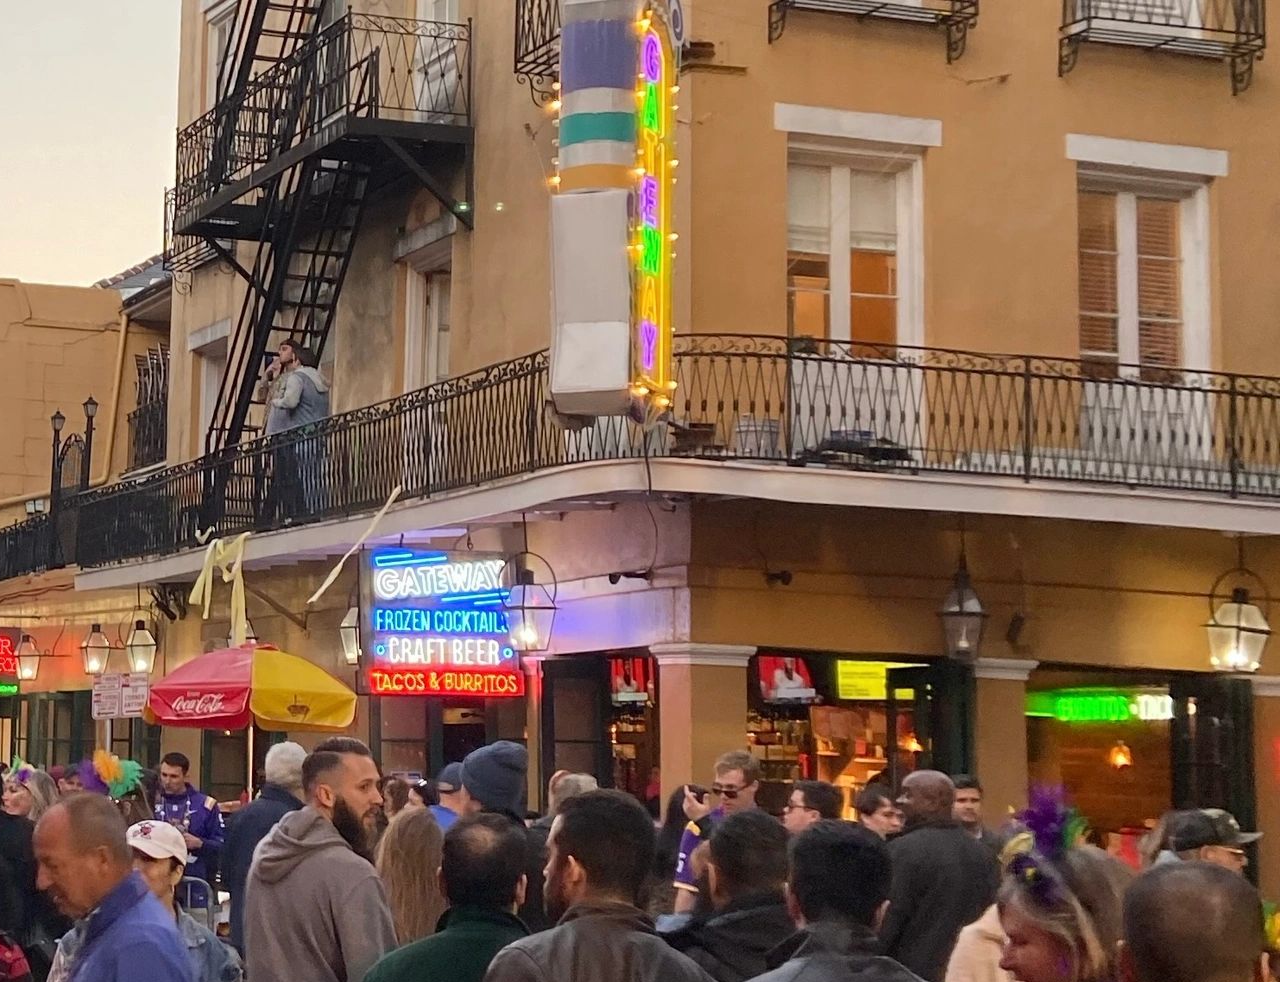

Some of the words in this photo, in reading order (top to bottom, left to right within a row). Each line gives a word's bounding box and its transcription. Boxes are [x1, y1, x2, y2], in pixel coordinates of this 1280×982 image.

[376, 560, 505, 599] GATEWAY
[376, 610, 430, 631] FROZEN
[388, 636, 447, 664] CRAFT
[452, 638, 502, 665] BEER
[372, 672, 425, 691] TACOS
[429, 671, 441, 690] &
[443, 673, 518, 693] BURRITOS
[172, 693, 225, 714] Coca-Cola
